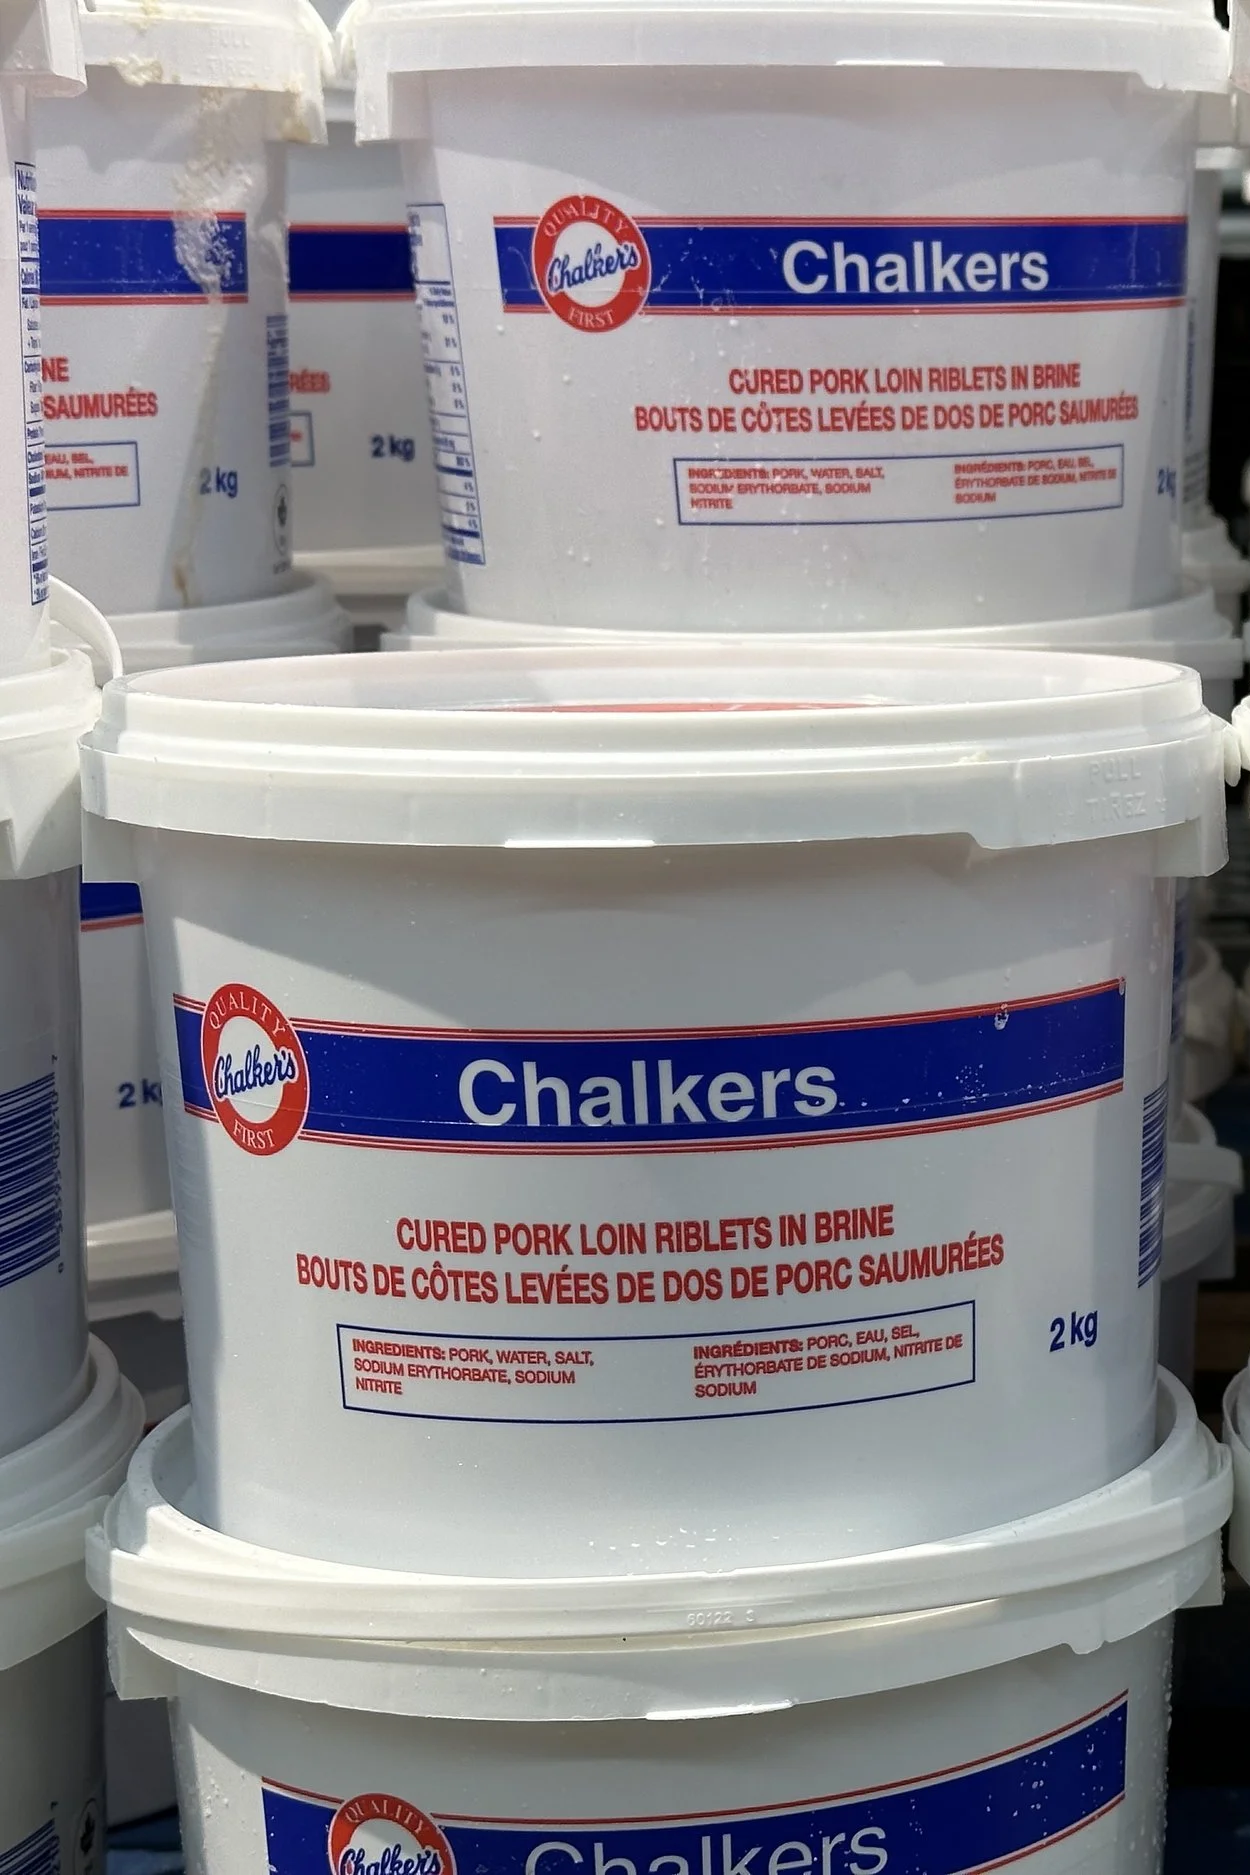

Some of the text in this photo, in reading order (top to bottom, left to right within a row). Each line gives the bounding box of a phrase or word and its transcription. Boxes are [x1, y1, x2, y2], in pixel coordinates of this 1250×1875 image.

[548, 243, 638, 291] Chalker's
[782, 240, 1050, 294] Chalkers
[568, 307, 614, 328] FIRST
[729, 363, 1080, 394] CURED PORK LOIN RIBLETS IN BRINE
[636, 391, 1138, 432] BOUTS DE CÔTES LEVÉES DE DOS DE PORC SAUMURÉES
[371, 434, 415, 461] 2 kg
[216, 467, 238, 497] kg
[209, 991, 286, 1037] QUALITY
[214, 1044, 296, 1098] Chalker's
[459, 1059, 838, 1126] Chalkers
[233, 1119, 274, 1149] FIRST
[396, 1204, 894, 1256] CURED PORK LOIN RIBLETS IN BRINE
[296, 1230, 1005, 1304] BOUTS DE CÔTES LEVÉES DE DOS DE PORC SAUMURÉES
[694, 1325, 920, 1360] INGRÉDIENTS: PORC, EAU, SEL,
[1049, 1311, 1098, 1352] 2 kg
[352, 1339, 594, 1367] INGREDIENTS: PORK, WATER, SALT,
[695, 1334, 963, 1379] ÉRYTHORBATE DE SODIUM, NITRITE DE
[354, 1359, 576, 1385] SODIUM ERYTHORBATE, SODIUM
[356, 1377, 402, 1395] NITRITE
[695, 1382, 757, 1398] SODIUM
[345, 1799, 430, 1834] QUALITY
